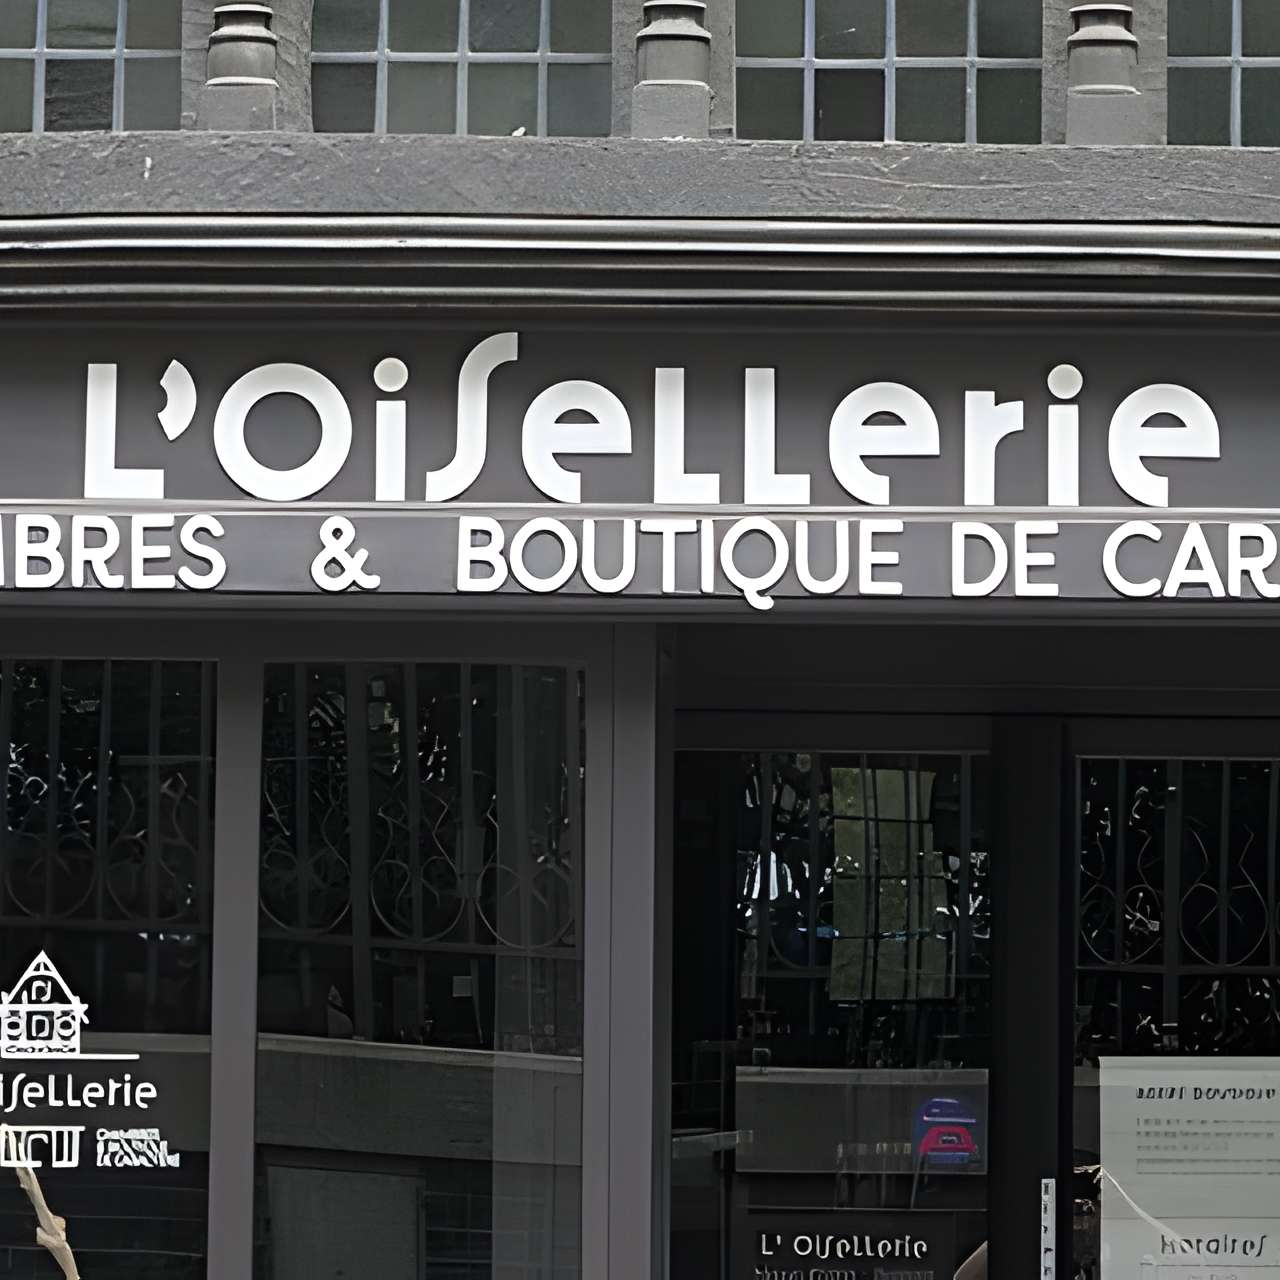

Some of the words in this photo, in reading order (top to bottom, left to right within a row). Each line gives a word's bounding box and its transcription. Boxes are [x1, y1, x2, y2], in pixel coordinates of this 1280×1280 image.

[310, 515, 381, 592] &
[456, 515, 904, 611] BOUTIQUE
[951, 520, 1060, 599] DE
